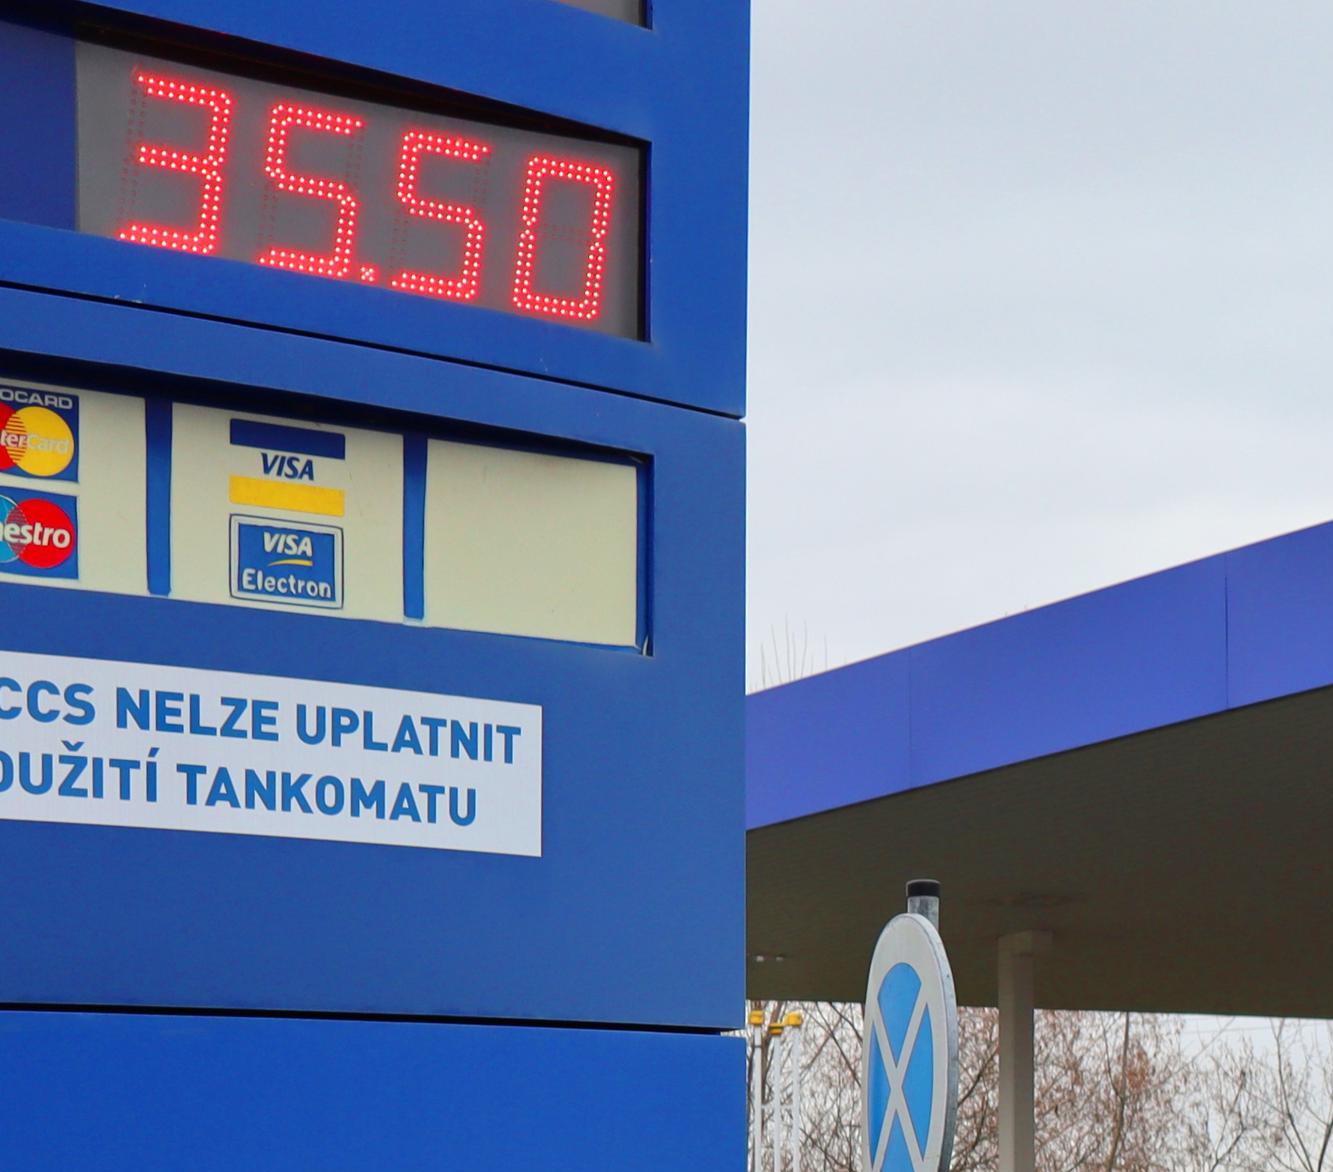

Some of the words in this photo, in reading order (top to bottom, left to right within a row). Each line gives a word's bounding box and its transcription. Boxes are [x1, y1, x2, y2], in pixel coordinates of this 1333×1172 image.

[117, 71, 615, 321] 35.50
[260, 452, 315, 481] VISA
[0, 521, 72, 549] estro
[263, 531, 313, 557] VISA
[241, 567, 332, 599] Electron
[116, 686, 280, 742] NELZE
[295, 703, 522, 765] UPLATNIT
[176, 762, 478, 827] TANKOMATU
